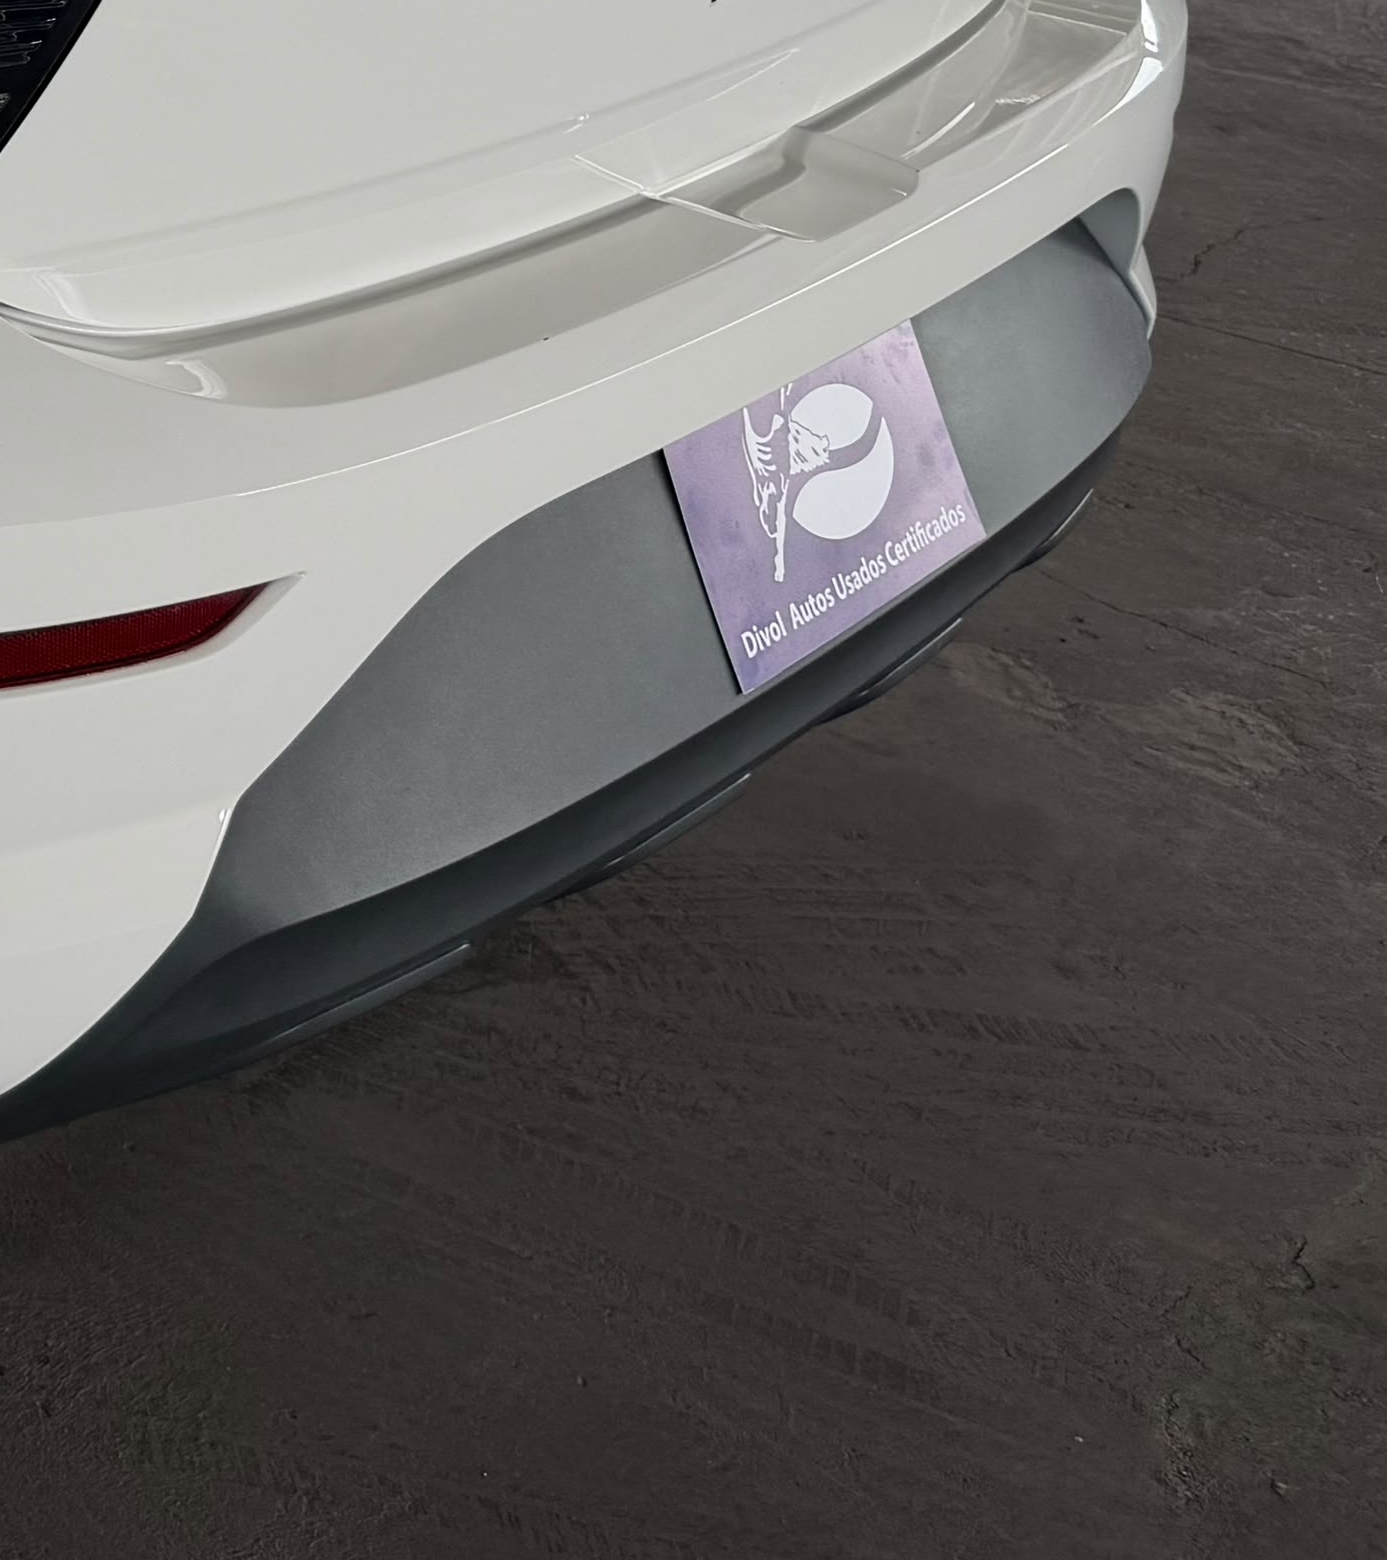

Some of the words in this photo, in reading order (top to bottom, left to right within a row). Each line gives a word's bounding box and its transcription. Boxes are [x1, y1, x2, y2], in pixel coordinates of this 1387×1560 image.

[740, 611, 788, 659] Divol
[788, 587, 836, 630] Autos
[831, 553, 888, 601] Usados
[884, 503, 967, 567] Certificados
